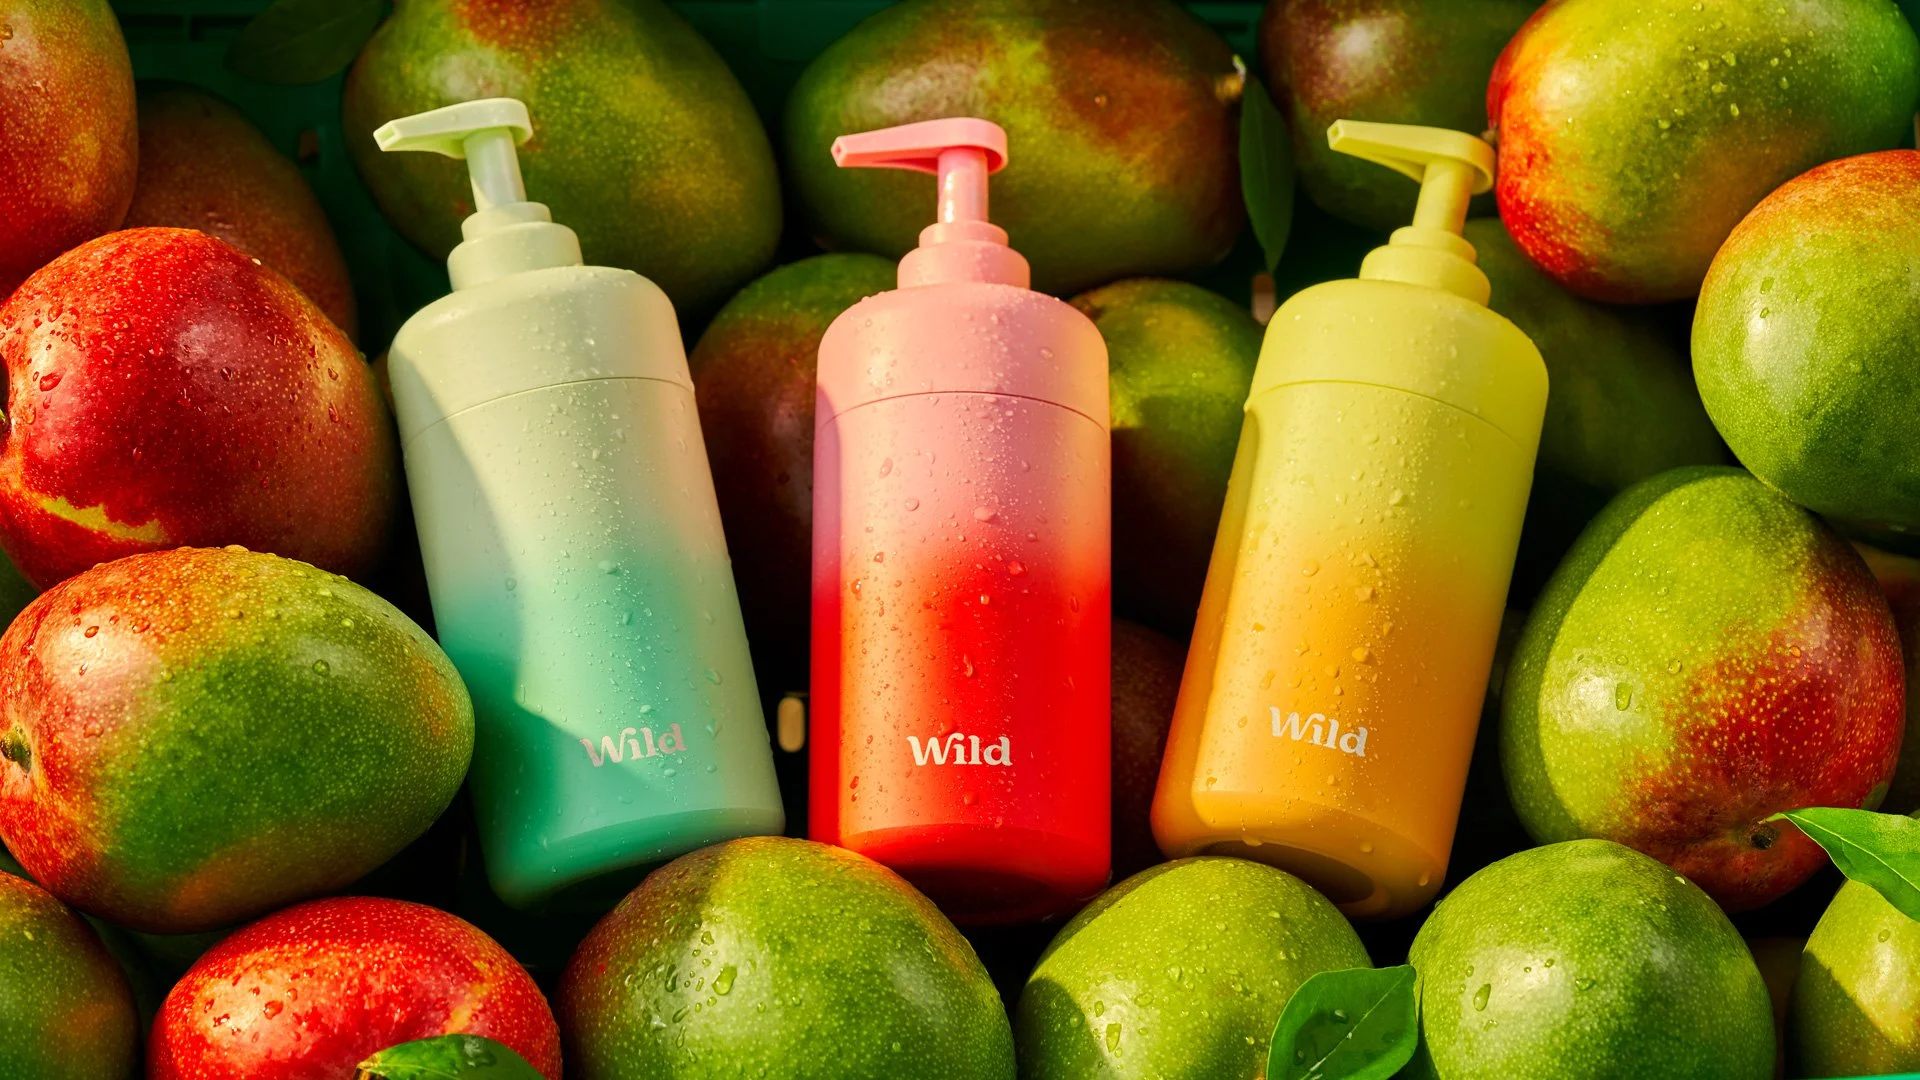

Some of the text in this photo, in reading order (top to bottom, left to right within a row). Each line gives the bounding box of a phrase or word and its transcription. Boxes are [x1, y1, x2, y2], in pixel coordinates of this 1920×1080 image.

[580, 722, 687, 768] Wild
[906, 732, 1013, 766] Wild
[1269, 706, 1368, 757] Wild
